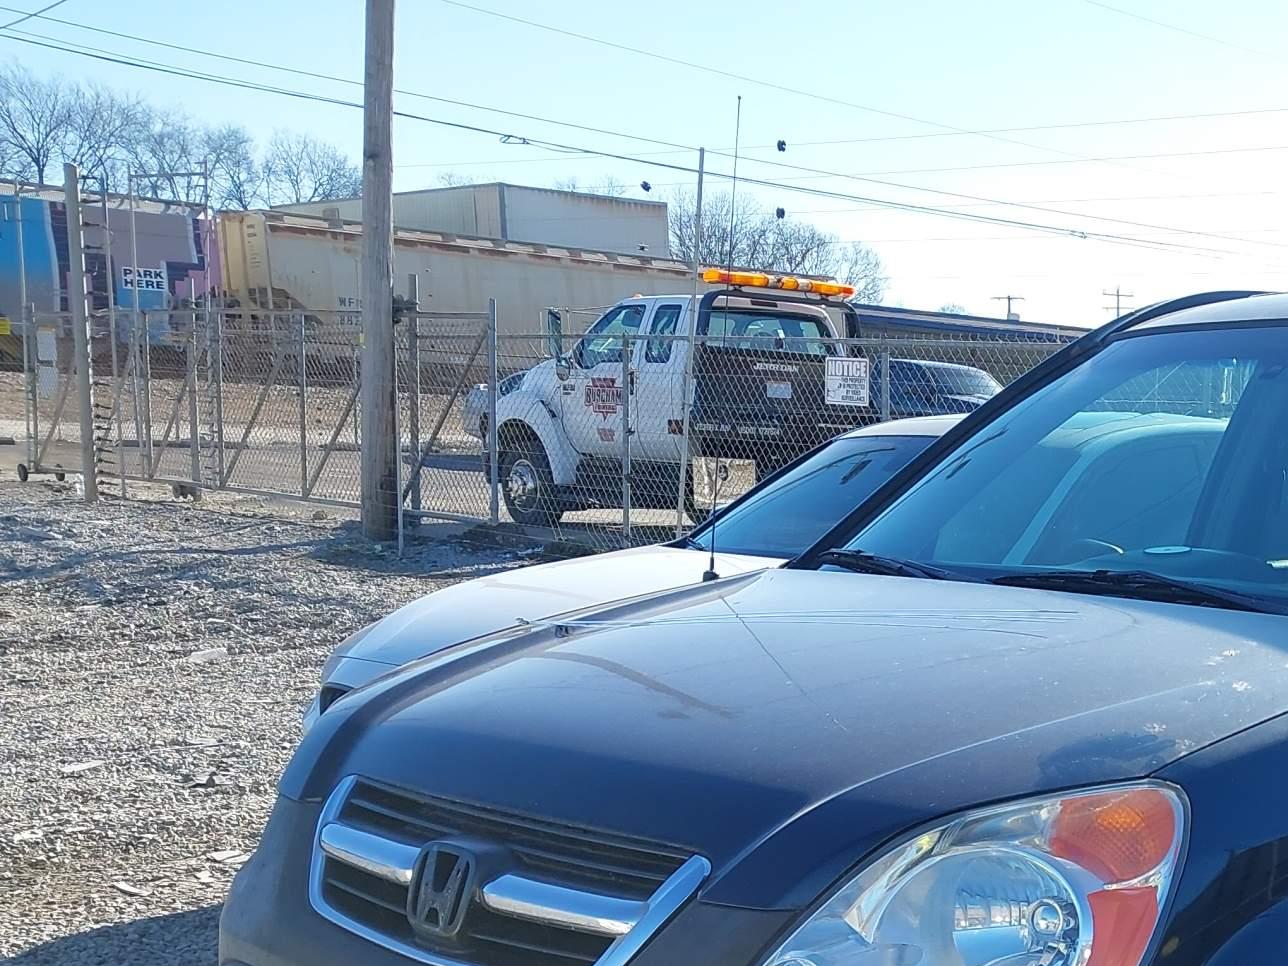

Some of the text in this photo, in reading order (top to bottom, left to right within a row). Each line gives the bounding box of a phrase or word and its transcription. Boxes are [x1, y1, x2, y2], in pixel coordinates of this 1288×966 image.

[123, 268, 164, 280] PARK
[124, 279, 165, 290] HERE
[828, 360, 866, 377] NOTICE
